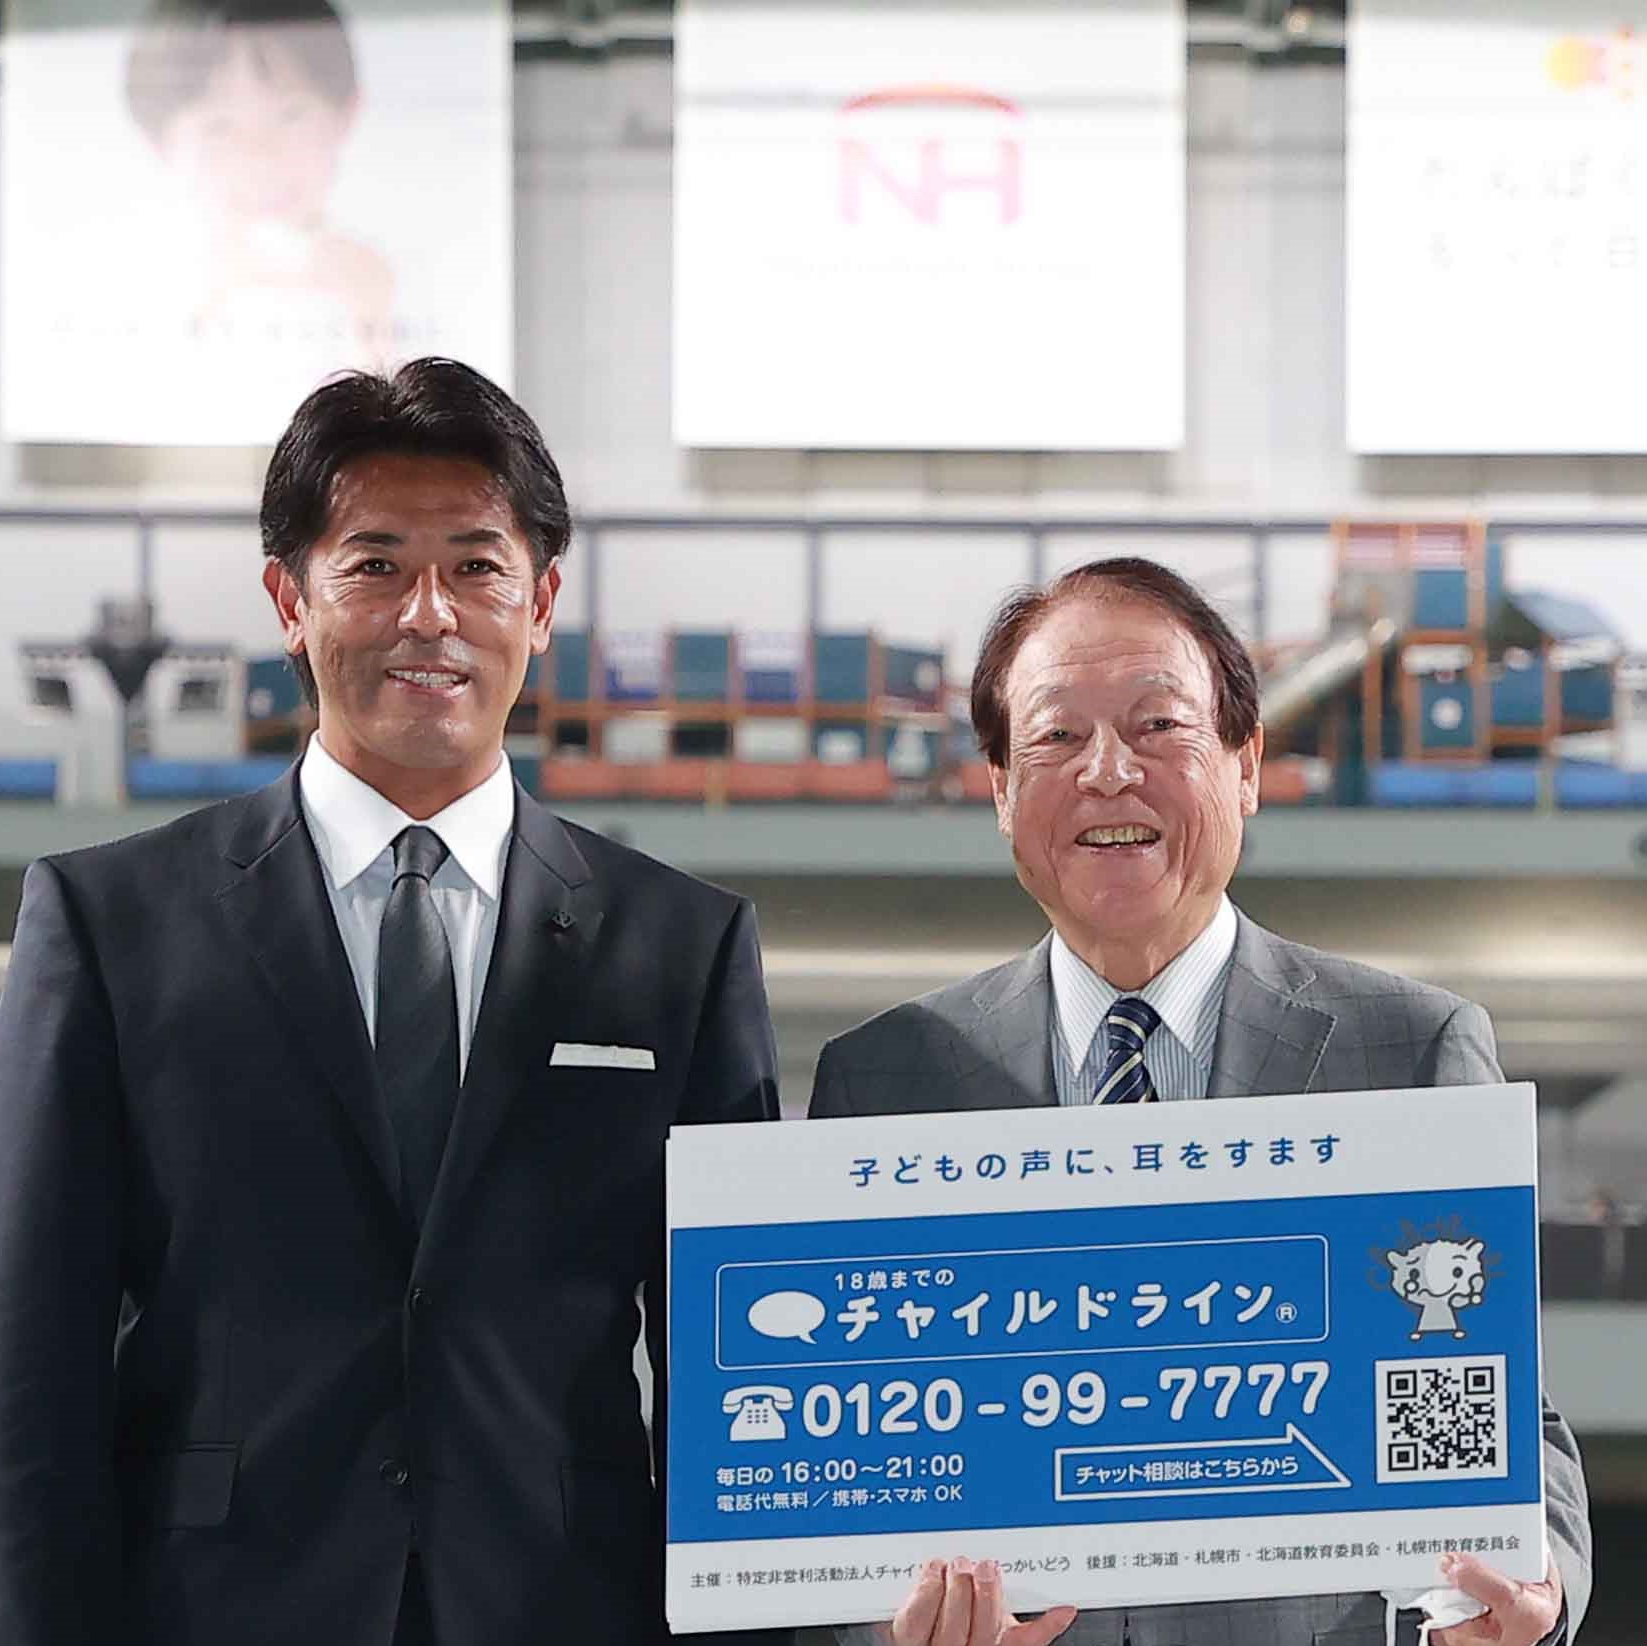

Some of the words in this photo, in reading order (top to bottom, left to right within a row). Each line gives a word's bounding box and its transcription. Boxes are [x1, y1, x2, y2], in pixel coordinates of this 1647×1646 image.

[848, 1133, 1341, 1187] 子どもの声に、耳をすます
[834, 1267, 955, 1291] 18歳までの
[715, 1467, 774, 1487] 毎日の
[1075, 1456, 1299, 1484] チャット相談はこちらから
[934, 1484, 963, 1501] OK
